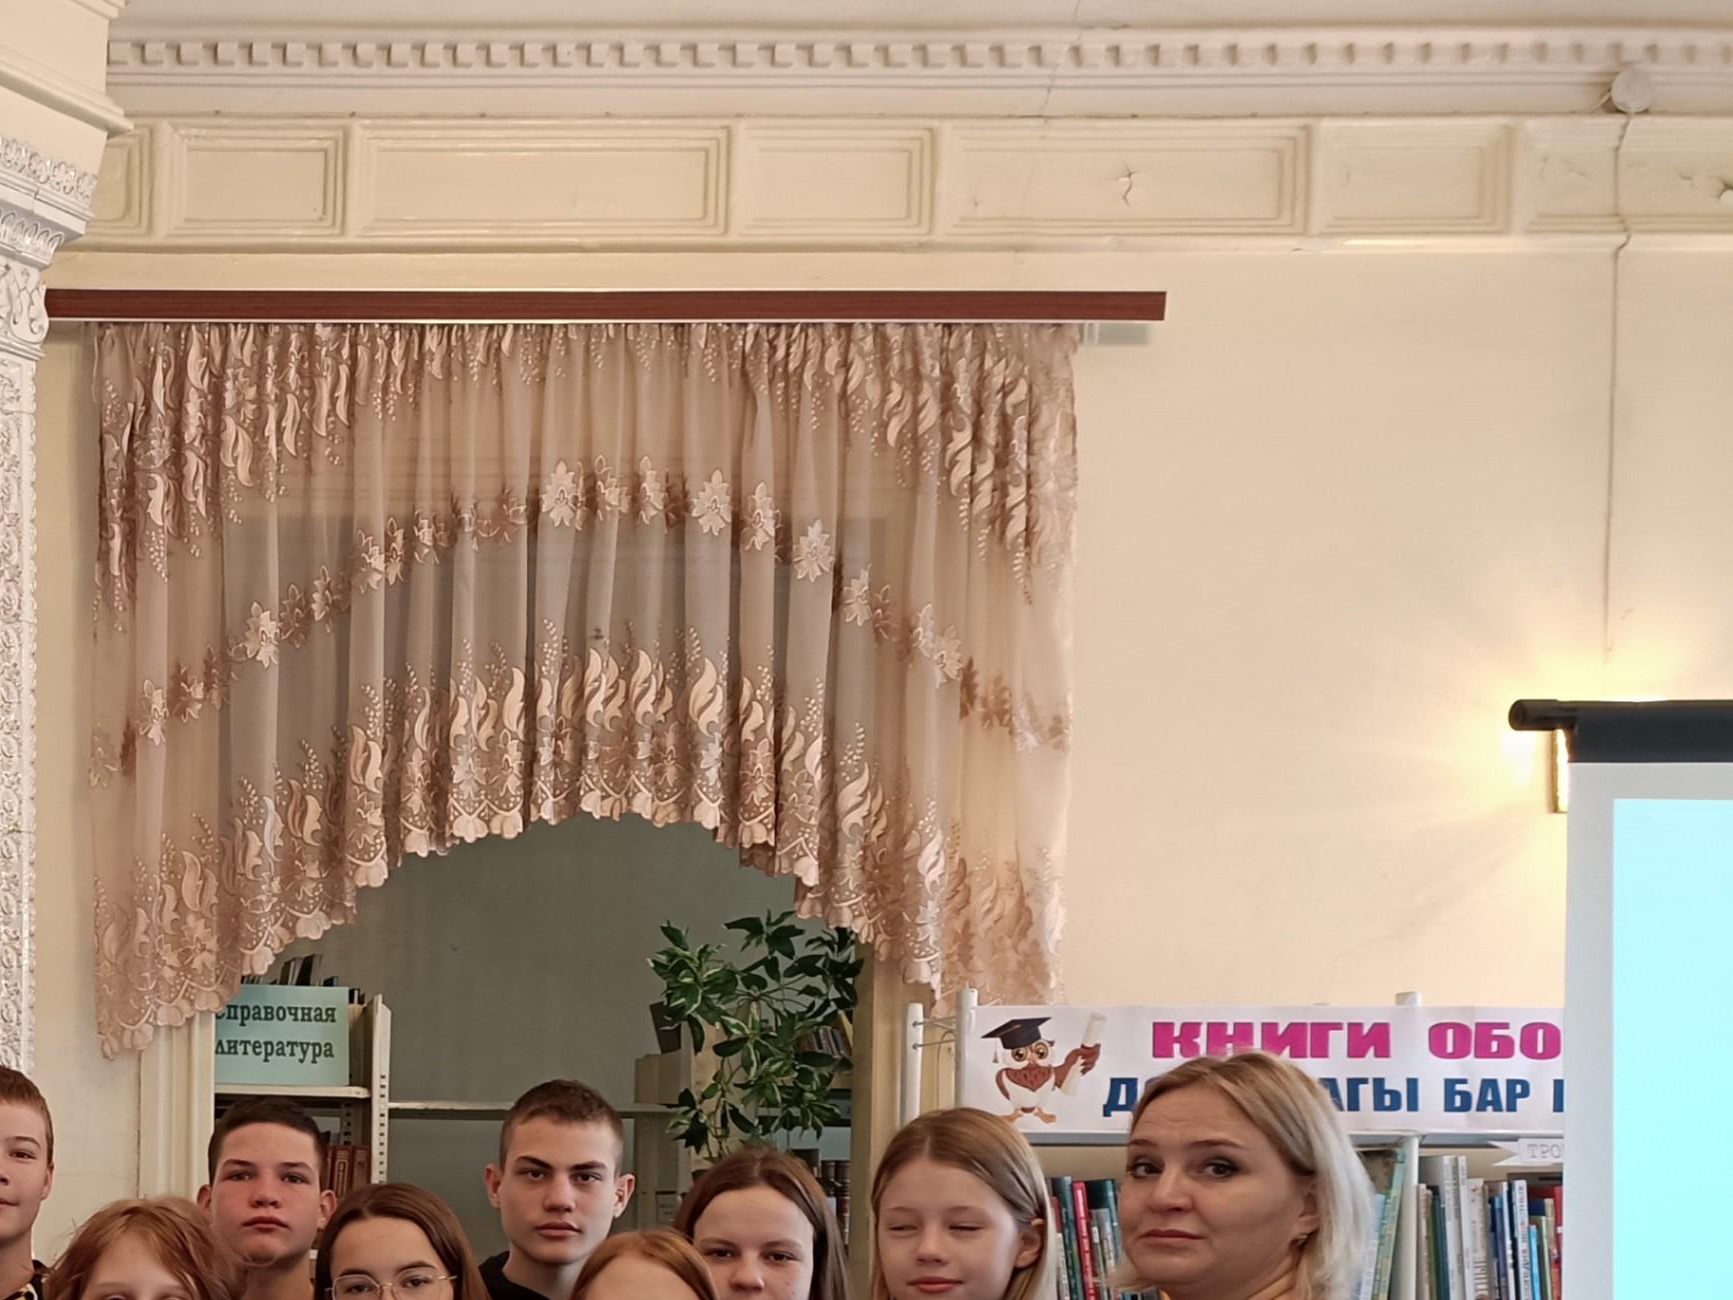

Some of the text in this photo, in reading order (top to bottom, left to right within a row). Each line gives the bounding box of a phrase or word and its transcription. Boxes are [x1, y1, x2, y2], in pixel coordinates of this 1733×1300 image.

[214, 1039, 335, 1064] литература
[1152, 1021, 1391, 1059] КНИГИ
[1443, 1077, 1531, 1112] БАР
[1526, 1143, 1564, 1159] ТРО
